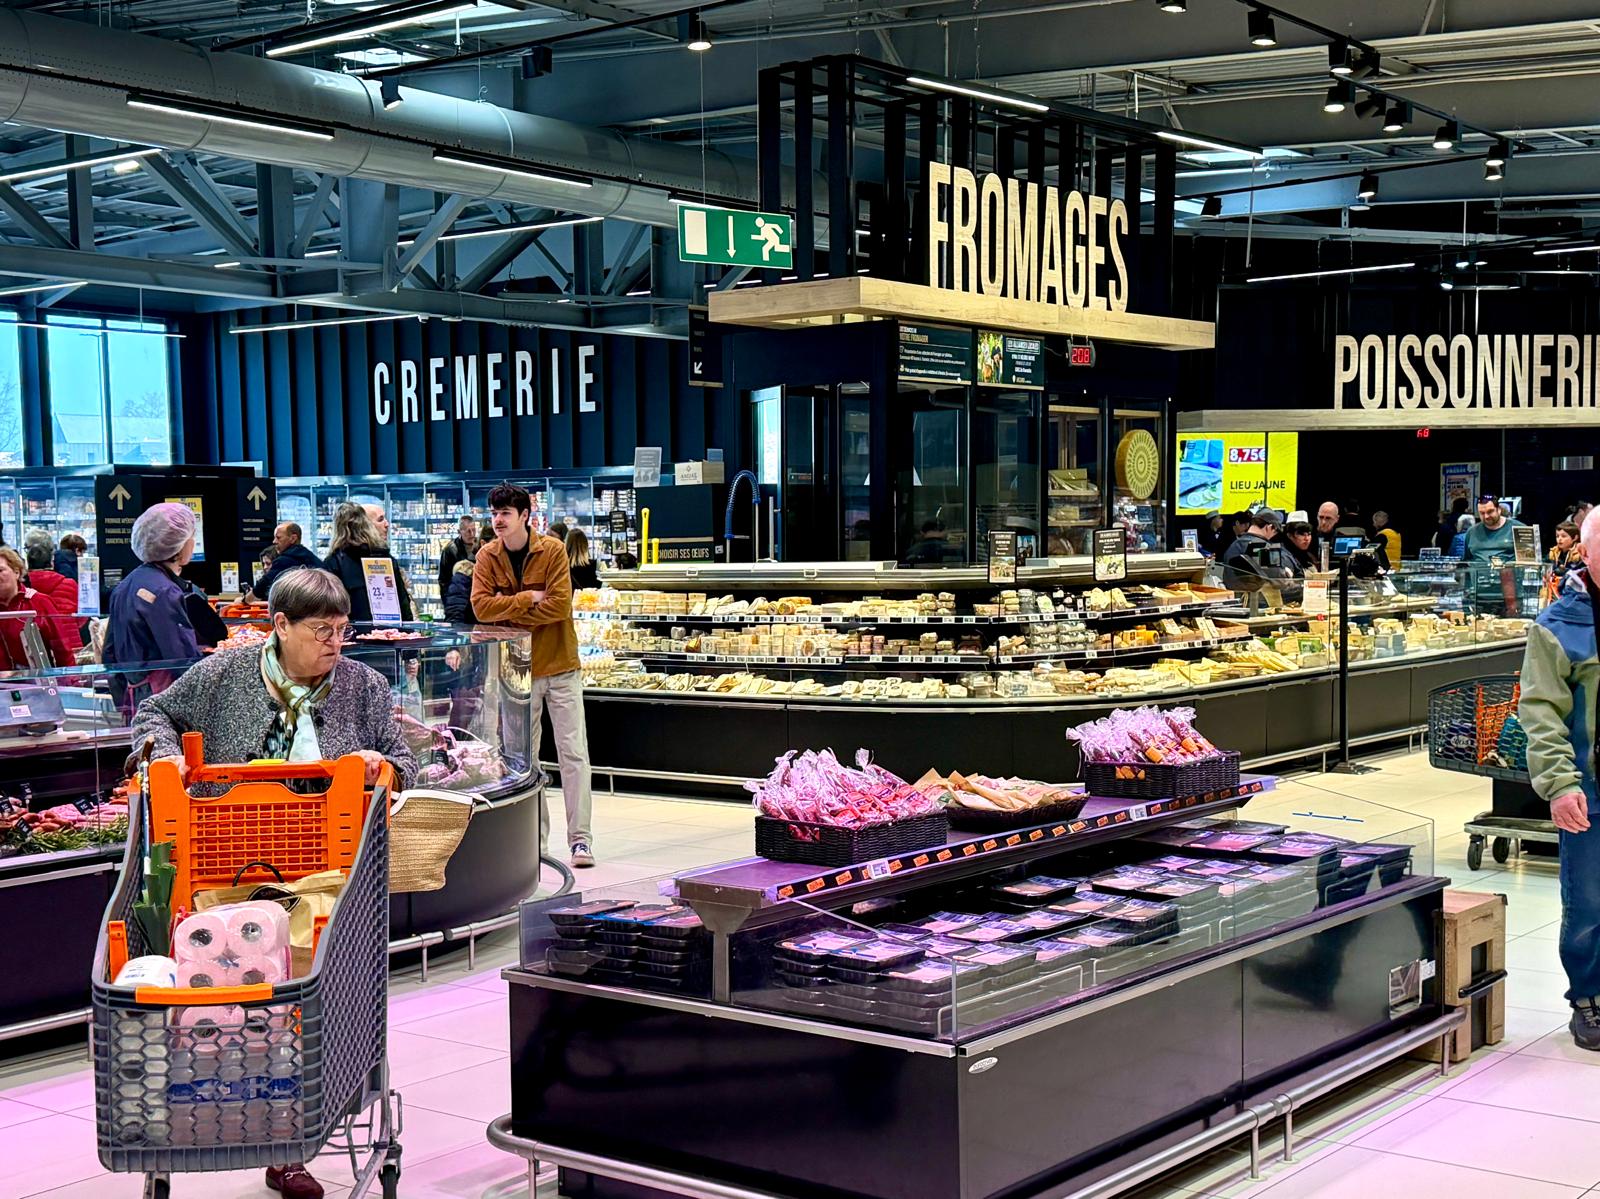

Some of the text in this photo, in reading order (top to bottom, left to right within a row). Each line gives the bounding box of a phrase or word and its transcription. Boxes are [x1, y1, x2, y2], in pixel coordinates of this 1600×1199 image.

[929, 161, 1128, 313] FROMAGES
[1071, 348, 1090, 363] 208
[1334, 334, 1600, 409] POISSONNERI
[374, 345, 596, 425] CREMERIE
[1230, 480, 1286, 490] LIEU JAUNE
[680, 548, 691, 559] SES
